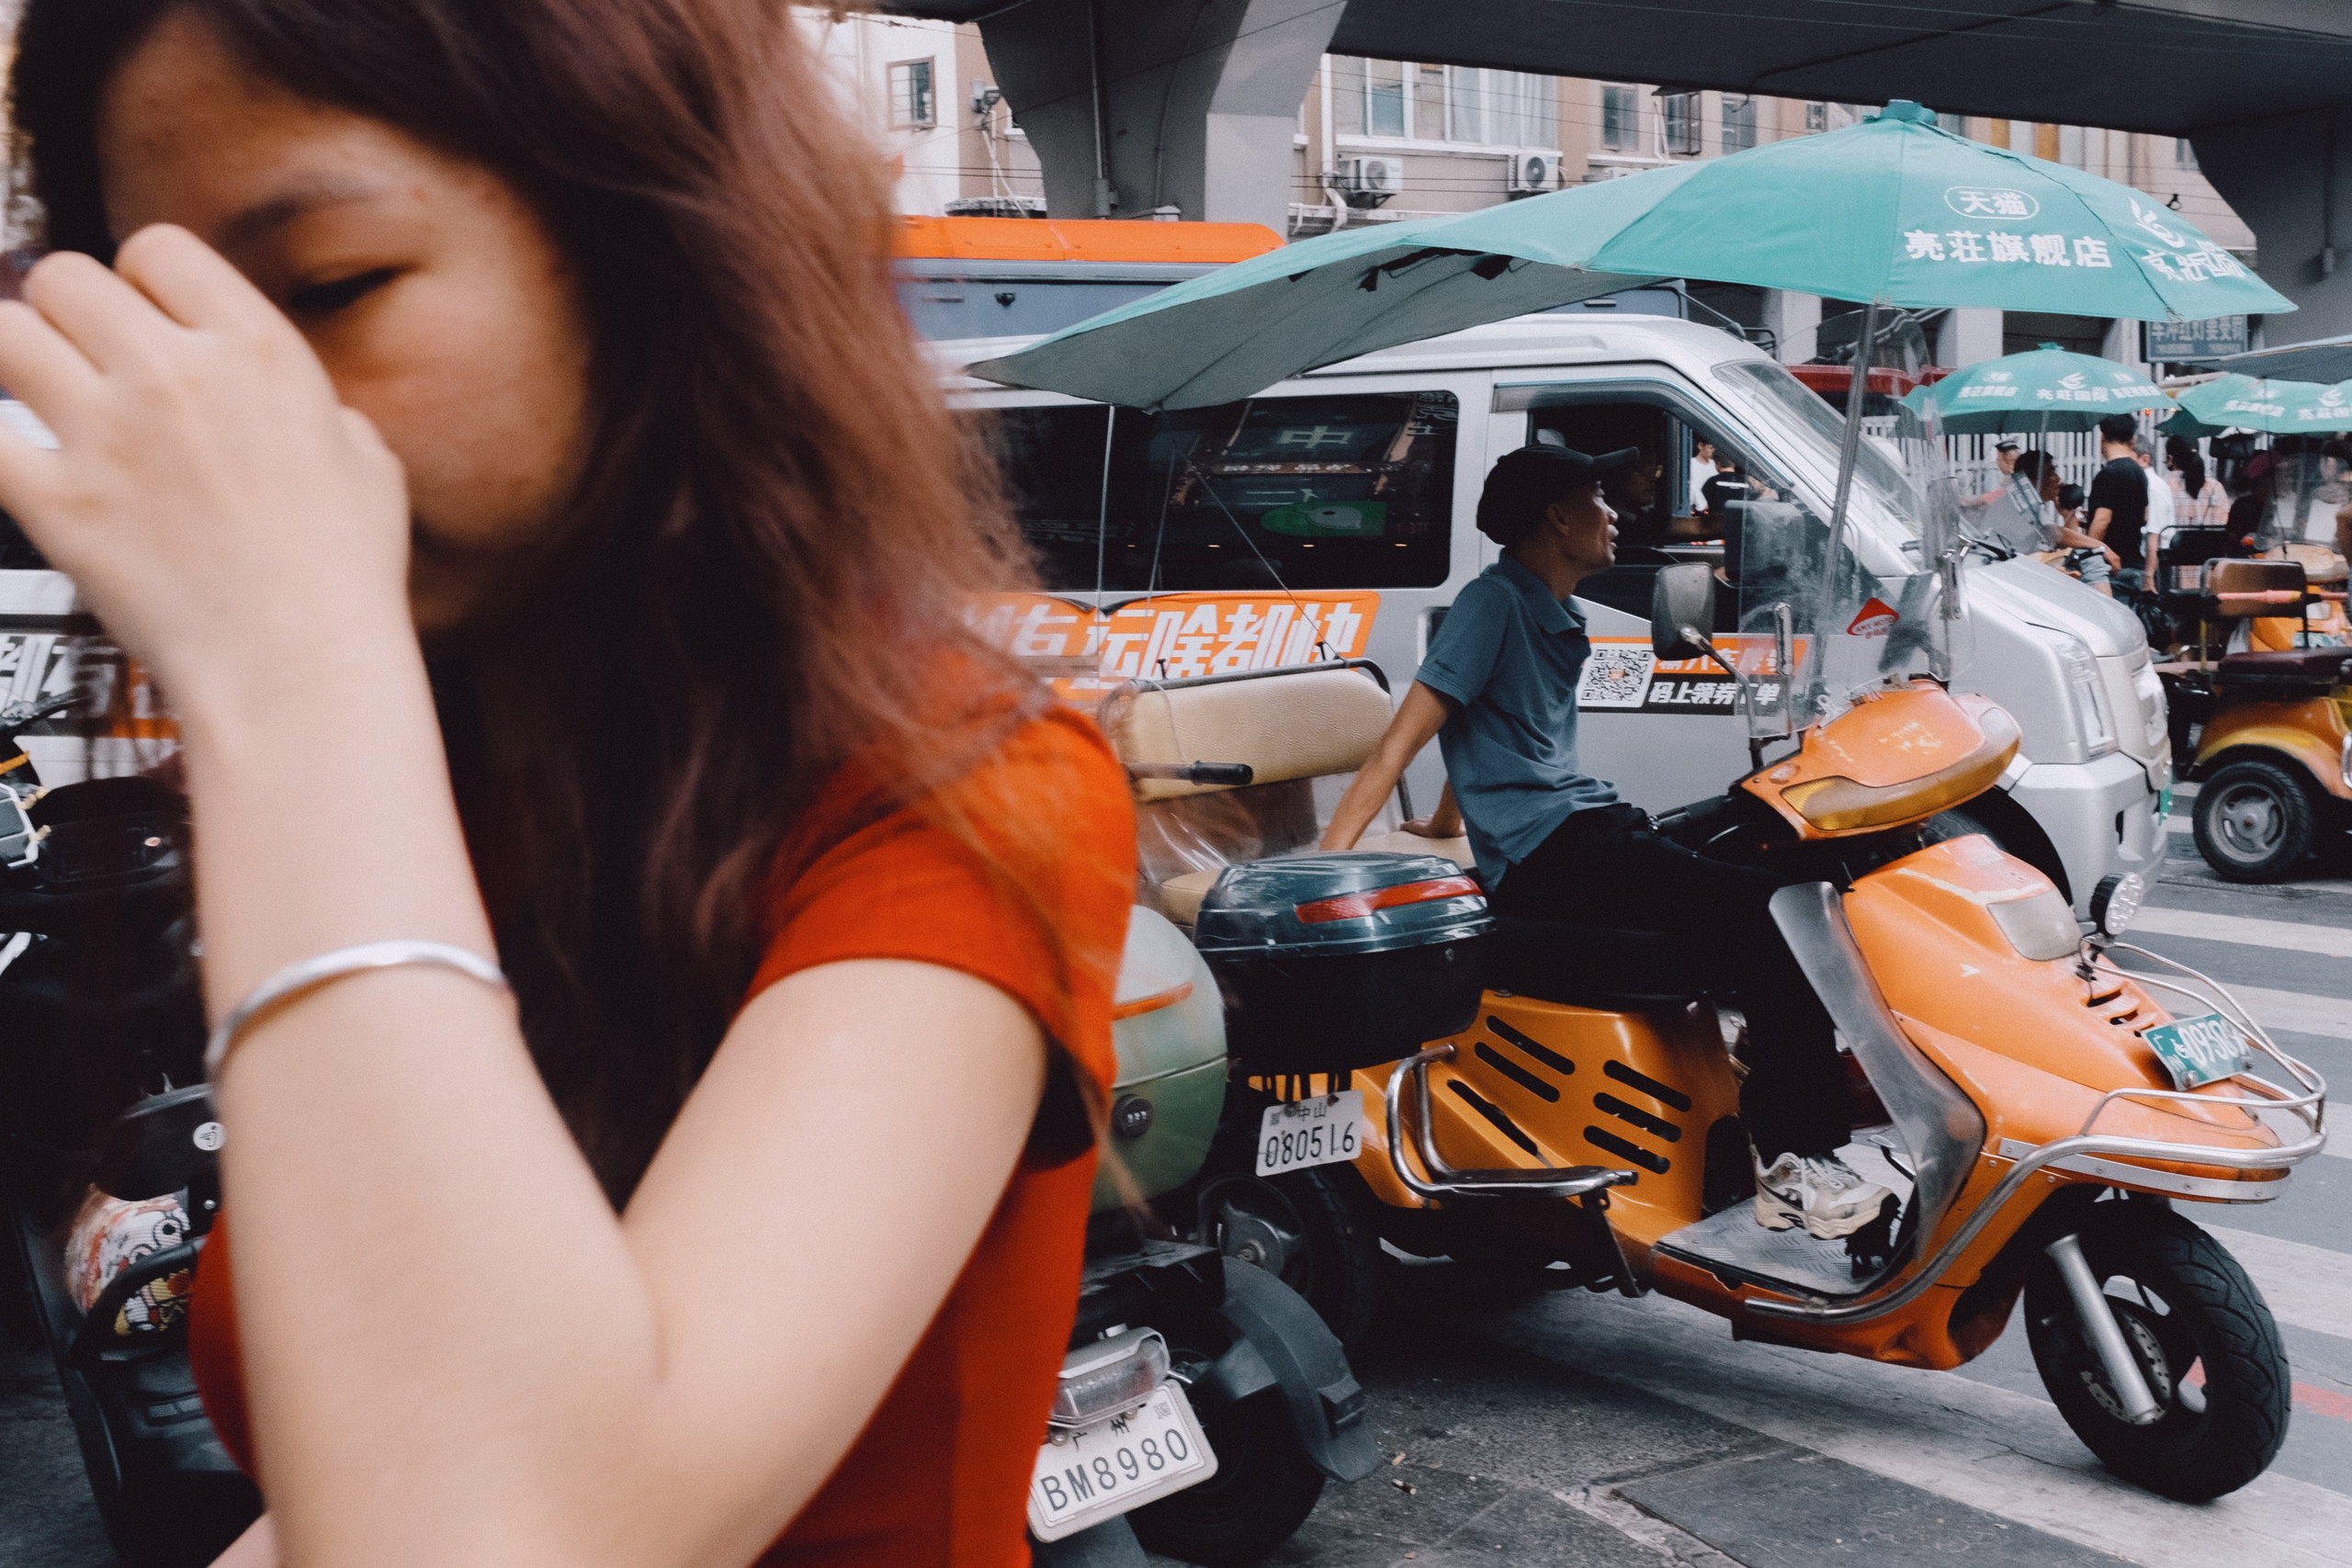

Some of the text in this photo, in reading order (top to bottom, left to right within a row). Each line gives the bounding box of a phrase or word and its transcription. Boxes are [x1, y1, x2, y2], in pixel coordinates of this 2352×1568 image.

[1959, 190, 2029, 215] 天猫
[1297, 1102, 1328, 1122] 中山
[1266, 1122, 1354, 1168] 080516
[1040, 1428, 1188, 1512] BM8980
